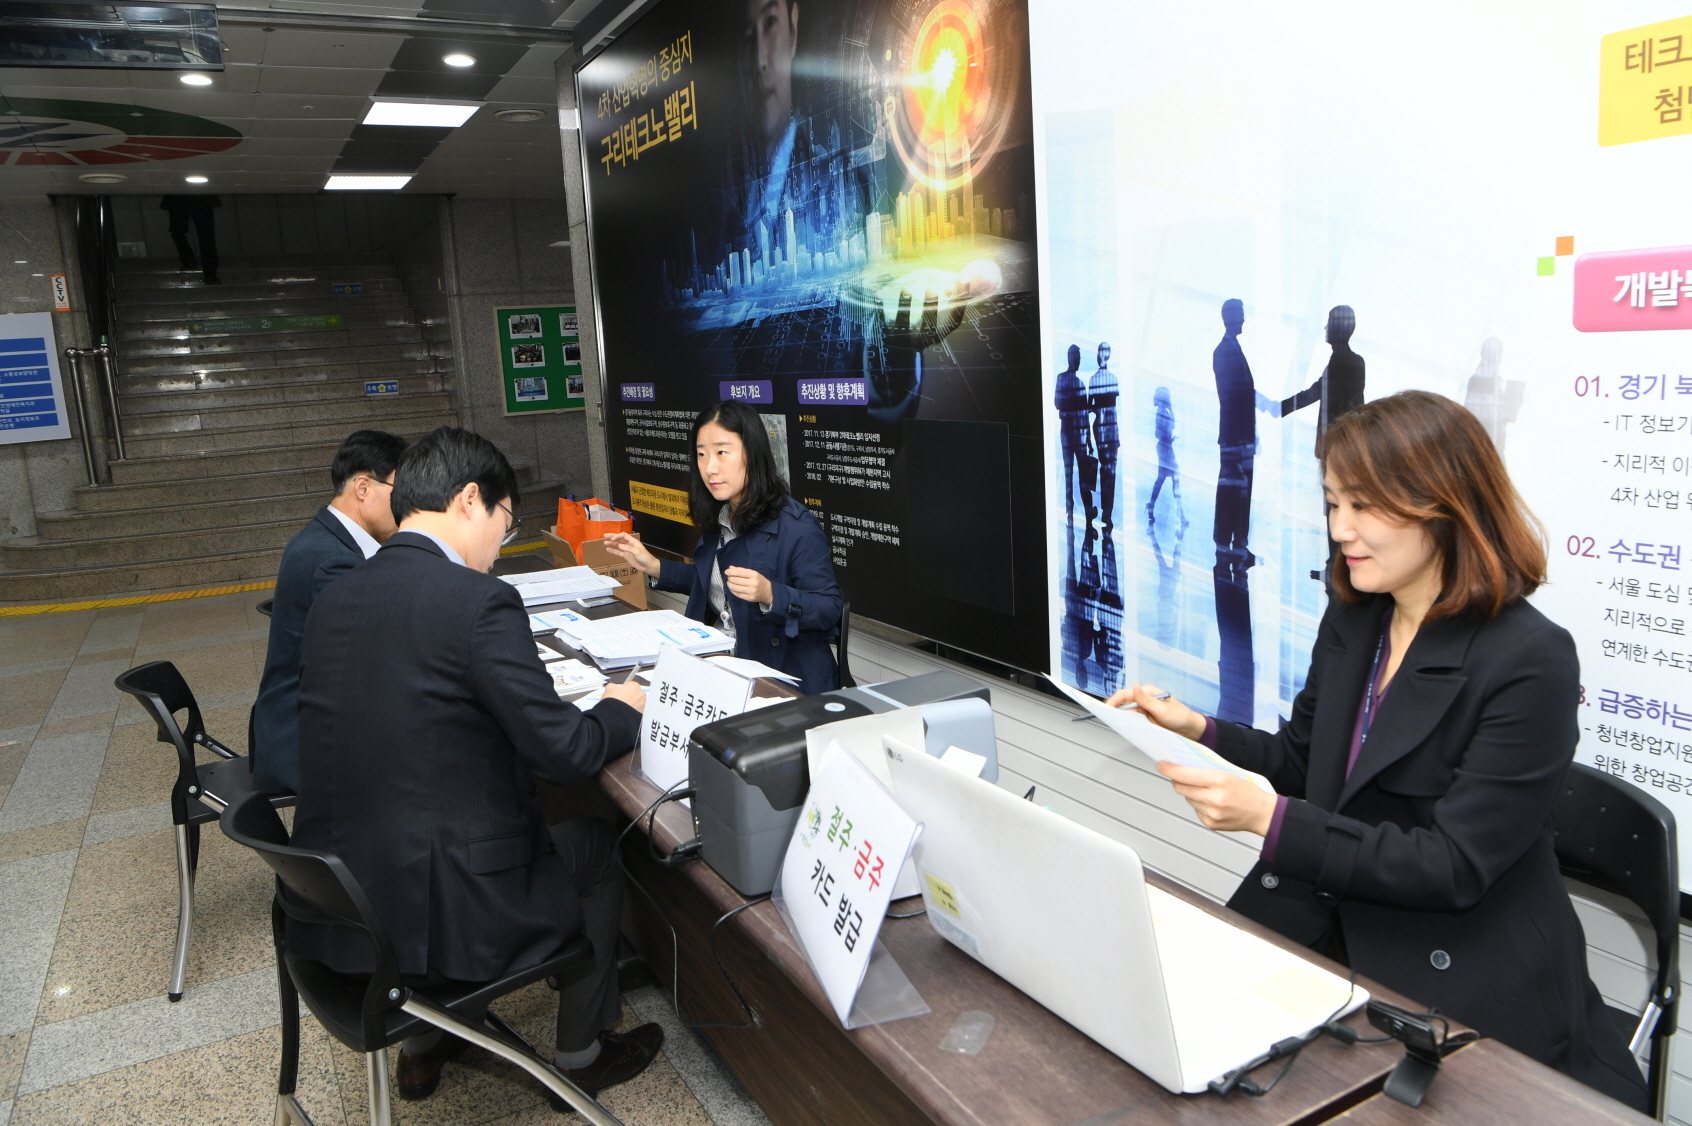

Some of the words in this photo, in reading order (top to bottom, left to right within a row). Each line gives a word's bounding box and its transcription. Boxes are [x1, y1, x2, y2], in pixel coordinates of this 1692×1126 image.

[1624, 35, 1692, 74] 테크
[598, 90, 610, 120] 4차
[612, 54, 658, 114] 산업혁명의
[660, 30, 692, 82] 중심지
[1654, 86, 1692, 124] 첨
[601, 80, 698, 176] 구리테크노밸리
[56, 276, 64, 302] CCTV
[261, 320, 272, 328] 2F
[730, 385, 747, 399] 후보지
[749, 385, 760, 399] 개요
[802, 383, 826, 400] 추진상황
[828, 384, 835, 399] 및
[836, 383, 865, 400] 향후계획
[1574, 376, 1609, 398] 01.
[1618, 374, 1666, 400] 경기
[1616, 415, 1633, 430] IT
[1614, 454, 1665, 474] 지리적
[1673, 457, 1692, 476] 이
[1610, 487, 1639, 506] 4차
[1644, 489, 1680, 510] 산업
[1567, 535, 1600, 559] 02.
[1608, 539, 1681, 570] 수도권
[1609, 577, 1641, 597] 서울
[1646, 582, 1680, 603] 도심
[1604, 608, 1686, 636] 지리적으로
[1602, 638, 1648, 664] 연계한
[1594, 754, 1626, 778] 위한
[810, 858, 835, 907] 카드
[834, 893, 863, 952] 발급
